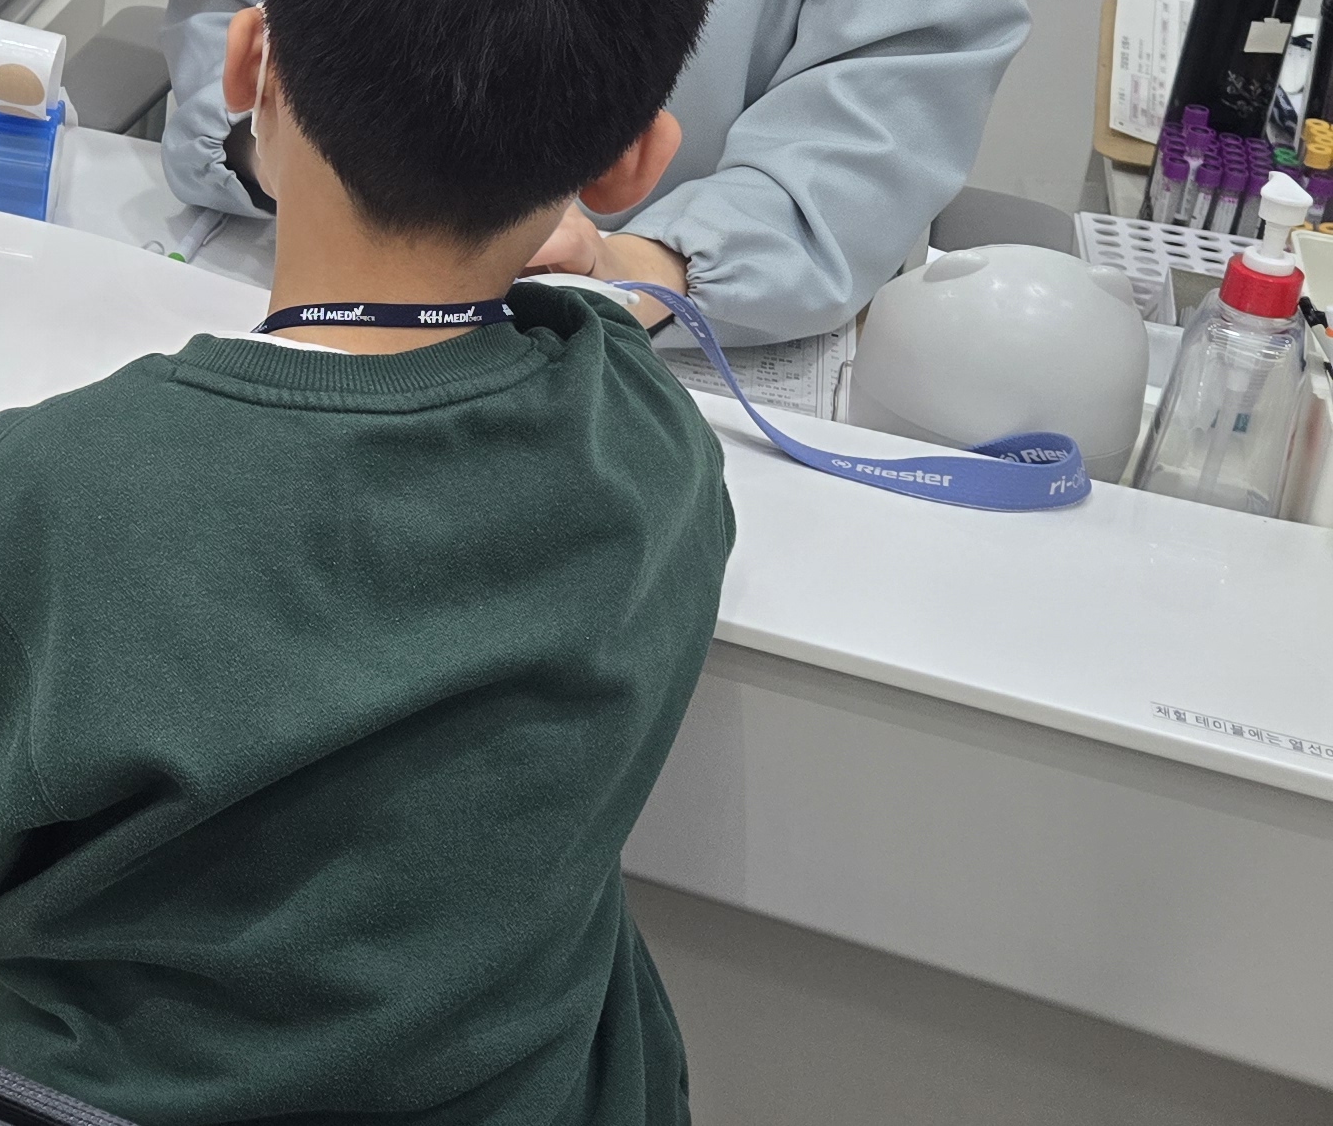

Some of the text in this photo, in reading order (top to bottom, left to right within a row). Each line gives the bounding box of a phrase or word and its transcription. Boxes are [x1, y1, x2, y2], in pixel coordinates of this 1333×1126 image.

[300, 307, 325, 321] KH
[326, 310, 356, 321] MEDI
[418, 310, 443, 324] KH
[444, 312, 469, 323] MEDI
[856, 464, 952, 486] Riester
[1156, 706, 1186, 722] 채혈
[1195, 715, 1282, 746] 테이블에는
